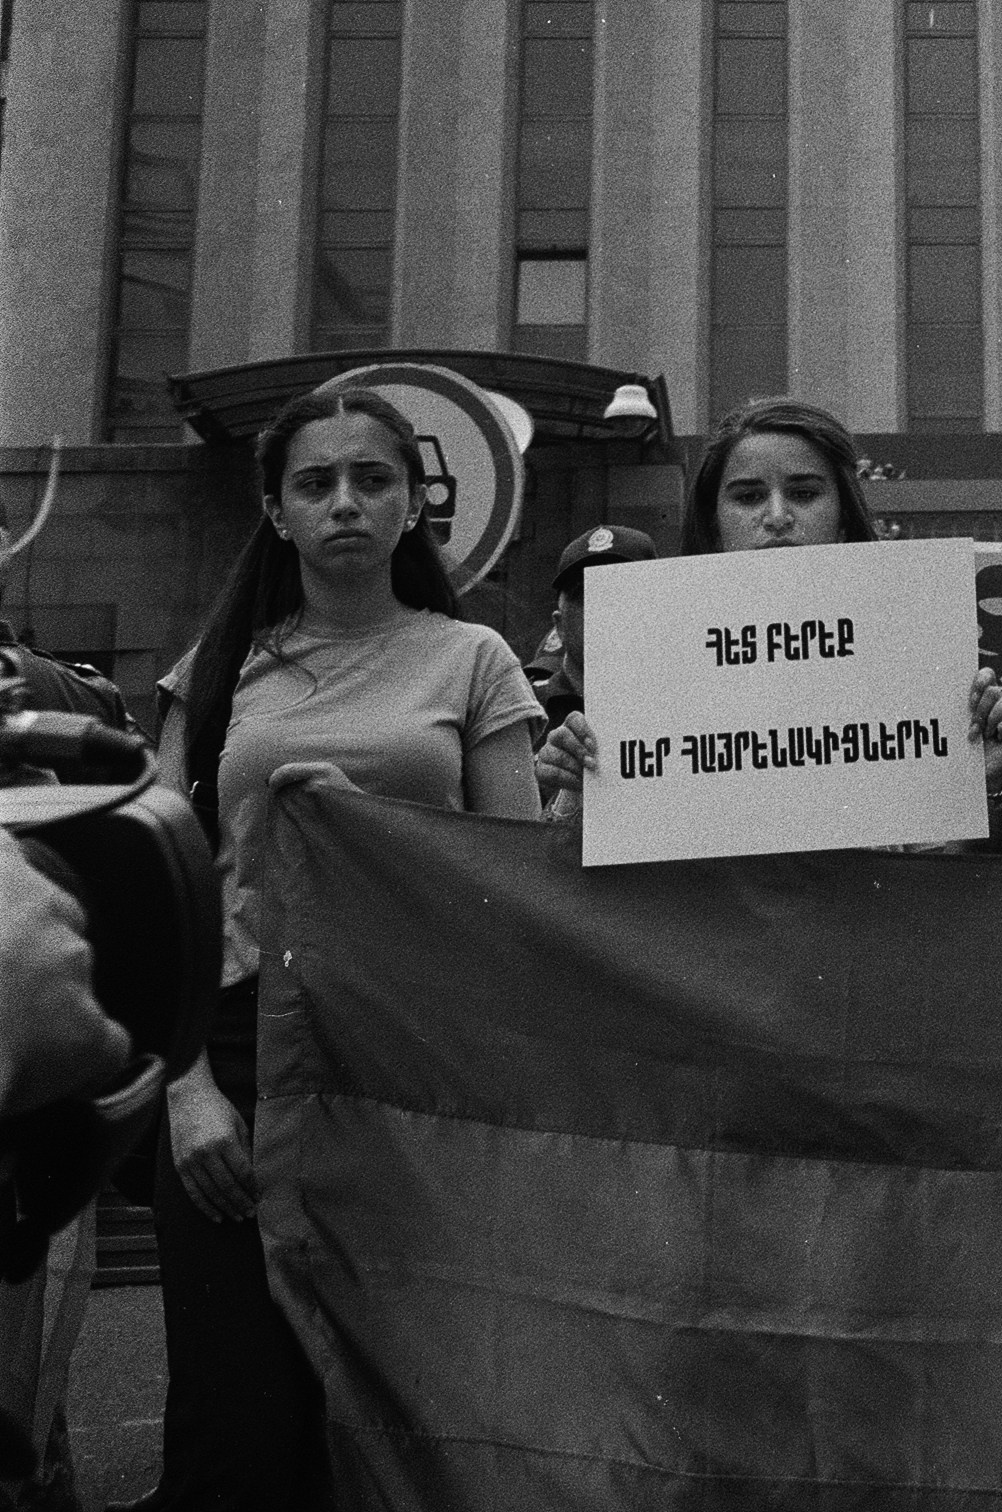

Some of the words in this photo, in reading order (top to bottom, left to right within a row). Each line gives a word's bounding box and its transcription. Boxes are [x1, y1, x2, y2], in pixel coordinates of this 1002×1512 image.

[705, 625, 757, 666] ՀԵՏ
[766, 618, 855, 662] ԲԵՐԵՔ
[620, 737, 671, 779] ՄԵՐ
[680, 718, 949, 775] ՀԱՅՐԵՆԱԿԻՑՆԵՐԻՆ
